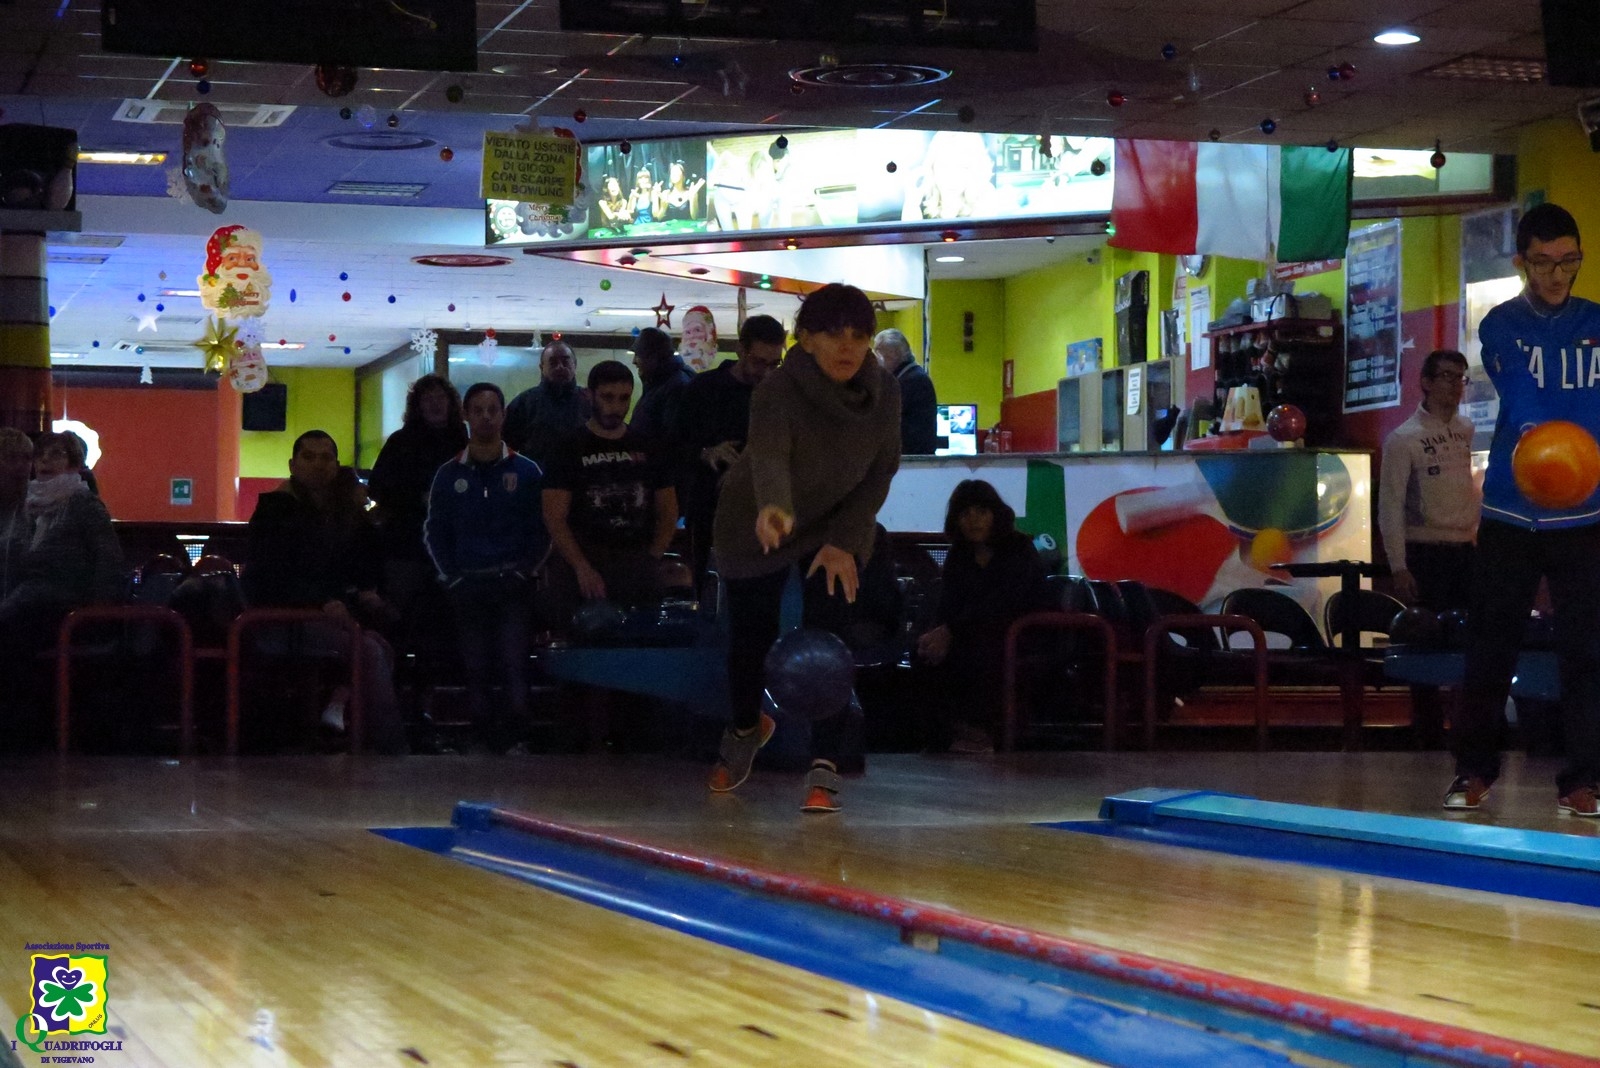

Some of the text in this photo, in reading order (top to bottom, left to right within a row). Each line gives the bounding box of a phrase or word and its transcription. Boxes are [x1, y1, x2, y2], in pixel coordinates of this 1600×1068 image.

[485, 135, 575, 154] VIETATO USCIRE
[494, 149, 565, 164] DALLA ZONA
[503, 161, 555, 175] DI GIOCO
[491, 171, 565, 186] CON SCARPE
[491, 183, 564, 198] DA BOWLING
[581, 451, 632, 467] MAFIA
